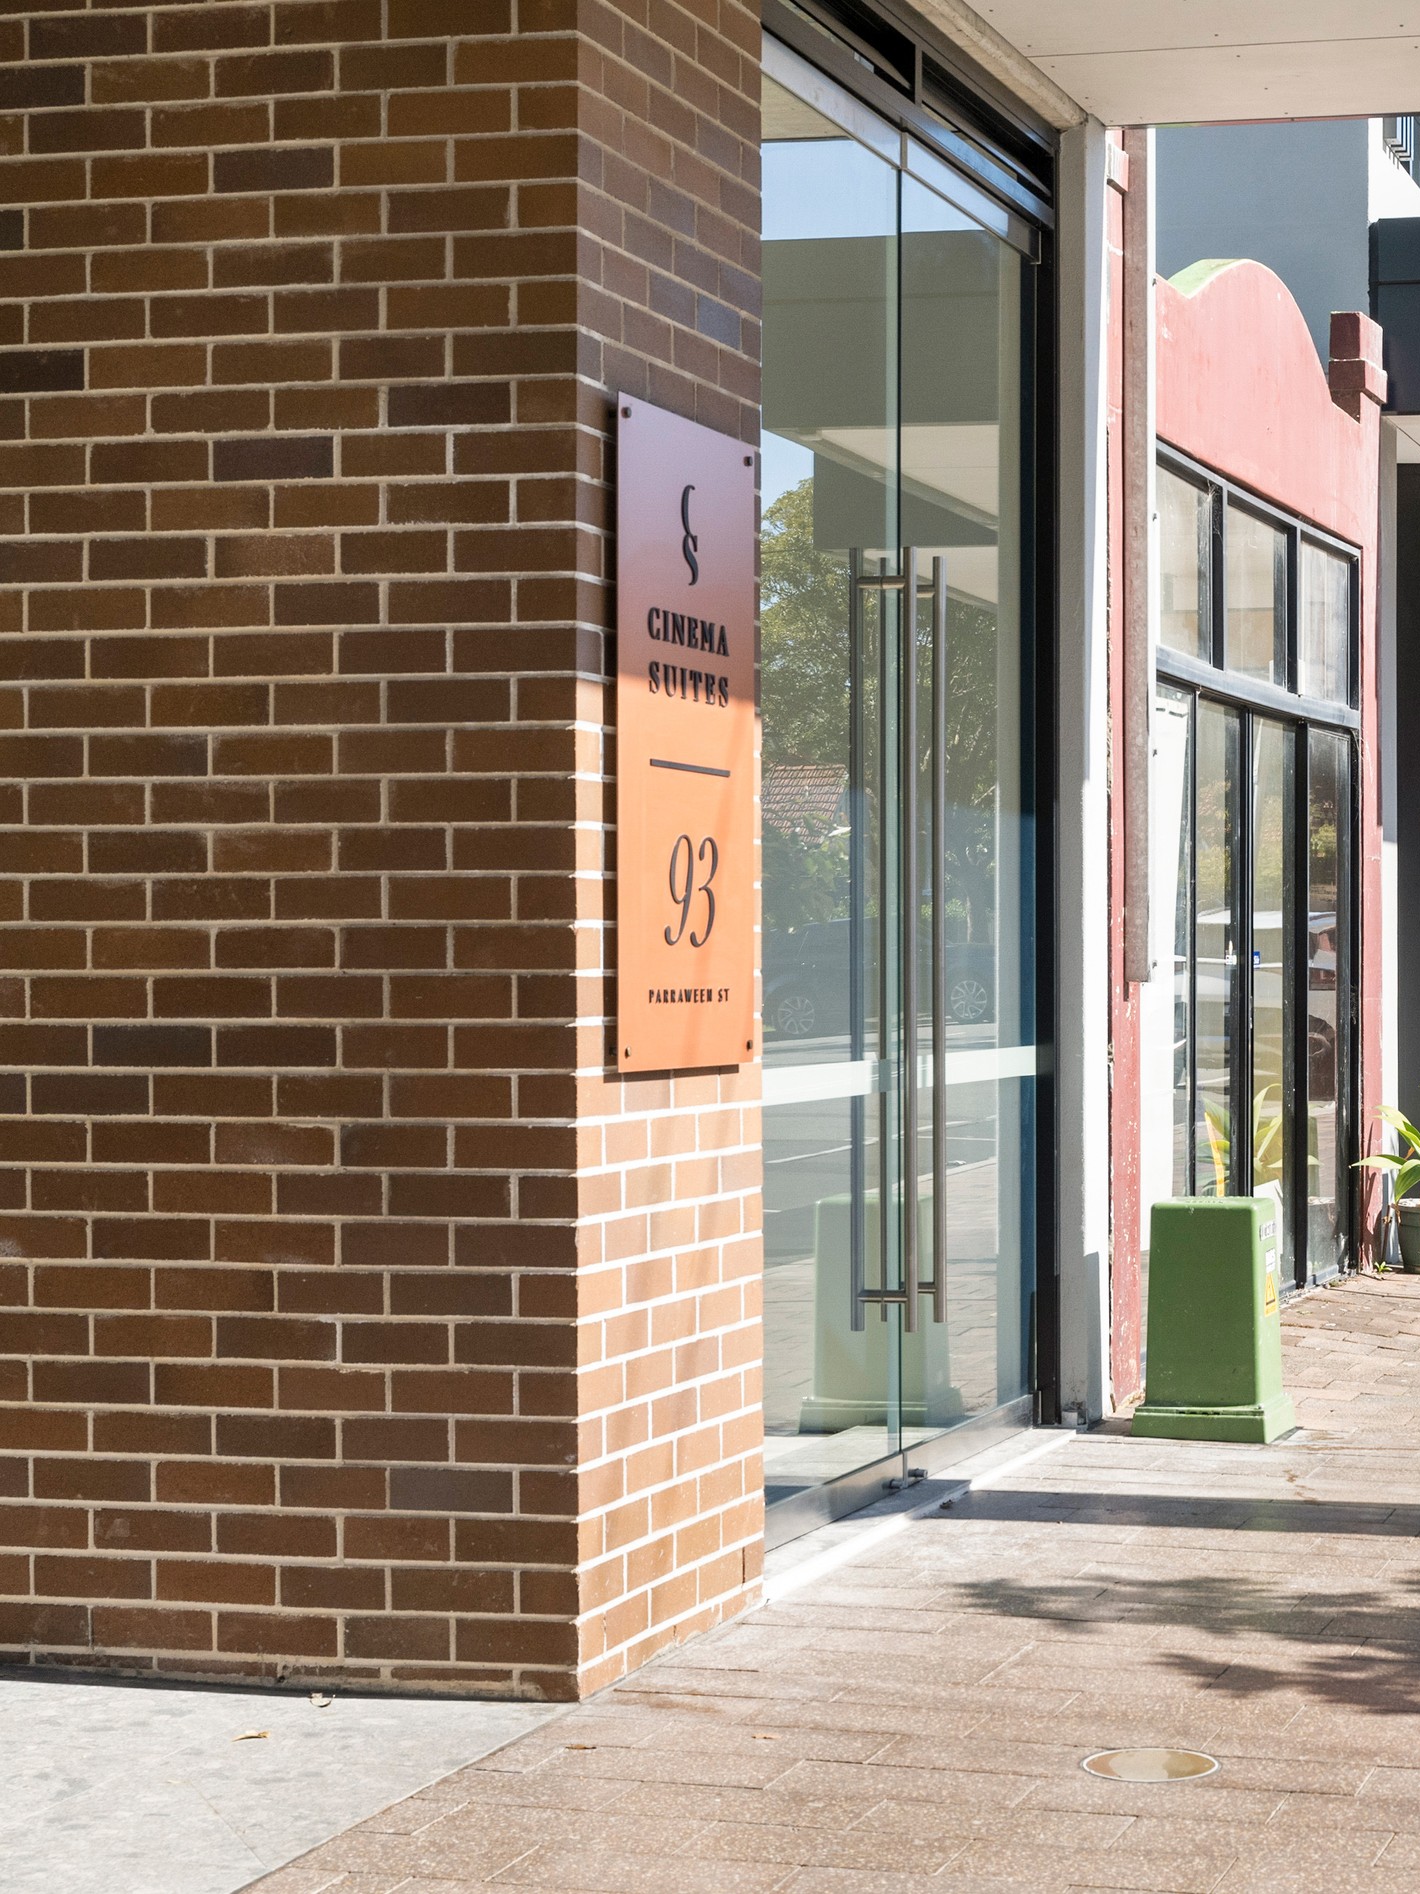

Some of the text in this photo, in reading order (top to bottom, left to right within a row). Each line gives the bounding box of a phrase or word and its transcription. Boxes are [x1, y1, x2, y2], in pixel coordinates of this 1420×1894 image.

[647, 607, 730, 657] CINEMA
[649, 661, 728, 708] SUITES
[664, 834, 719, 948] 93
[649, 987, 730, 1004] PARRAWEEN ST
